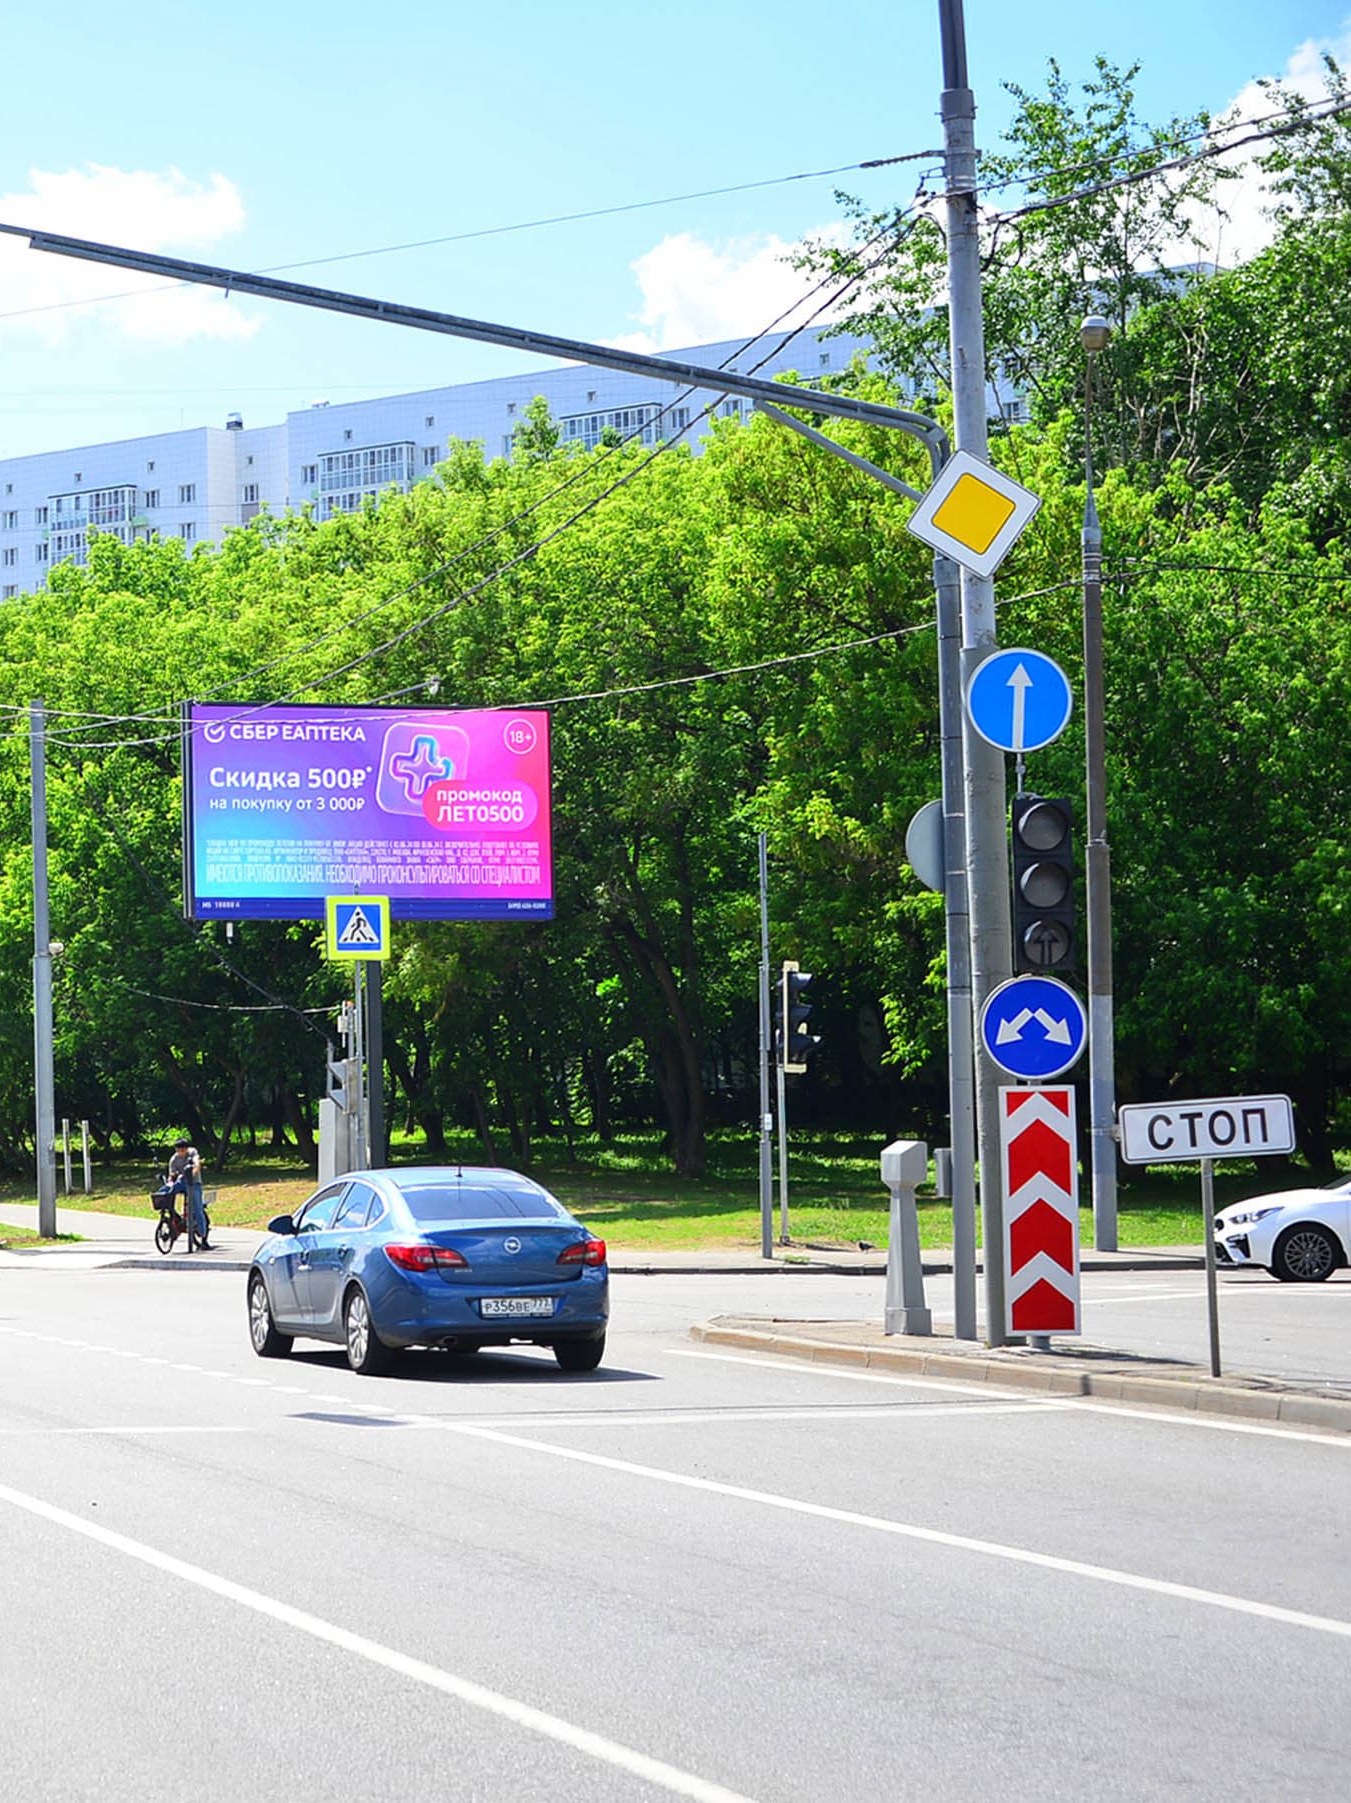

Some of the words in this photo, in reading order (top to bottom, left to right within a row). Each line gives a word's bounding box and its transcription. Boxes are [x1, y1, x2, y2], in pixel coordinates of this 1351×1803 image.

[229, 724, 279, 740] СБЕР
[281, 725, 367, 742] ЕАПТЕКА
[509, 730, 533, 744] 18+
[209, 767, 300, 791] Скидка
[209, 799, 227, 809] на
[232, 798, 292, 813] покупку
[295, 799, 313, 811] от
[316, 797, 326, 810] 3
[436, 789, 523, 804] промокод
[1147, 1107, 1269, 1151] СТОП
